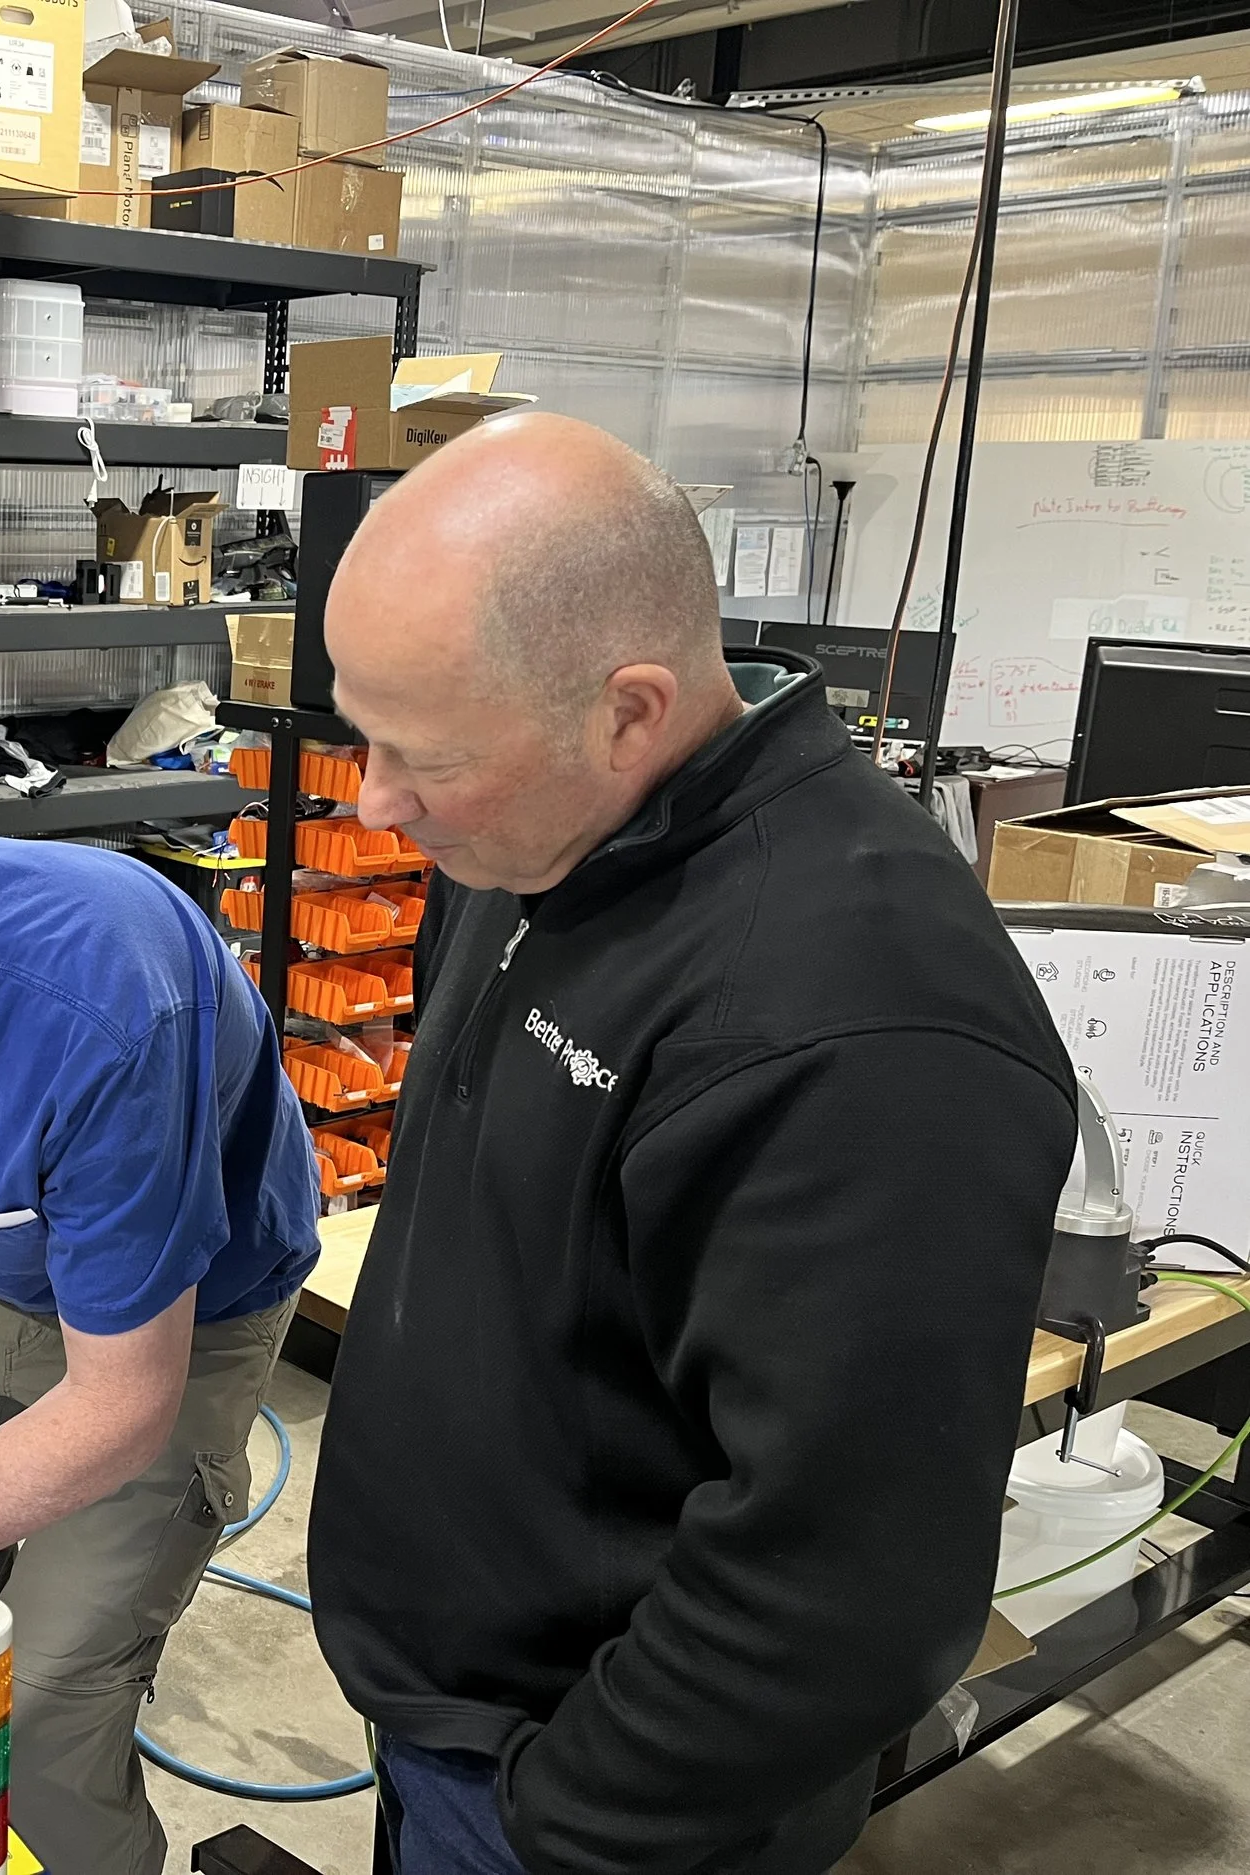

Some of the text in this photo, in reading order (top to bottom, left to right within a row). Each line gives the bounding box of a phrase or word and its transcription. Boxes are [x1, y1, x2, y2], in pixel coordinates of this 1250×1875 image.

[242, 468, 287, 486] INSIGHT
[815, 644, 887, 659] SCEPTRE
[1192, 960, 1222, 1072] APPLICATIONS
[1210, 960, 1236, 1066] DESCRIPTION AND
[1164, 1130, 1193, 1236] INSTRUCTIONS
[1191, 1132, 1206, 1166] QUICK
